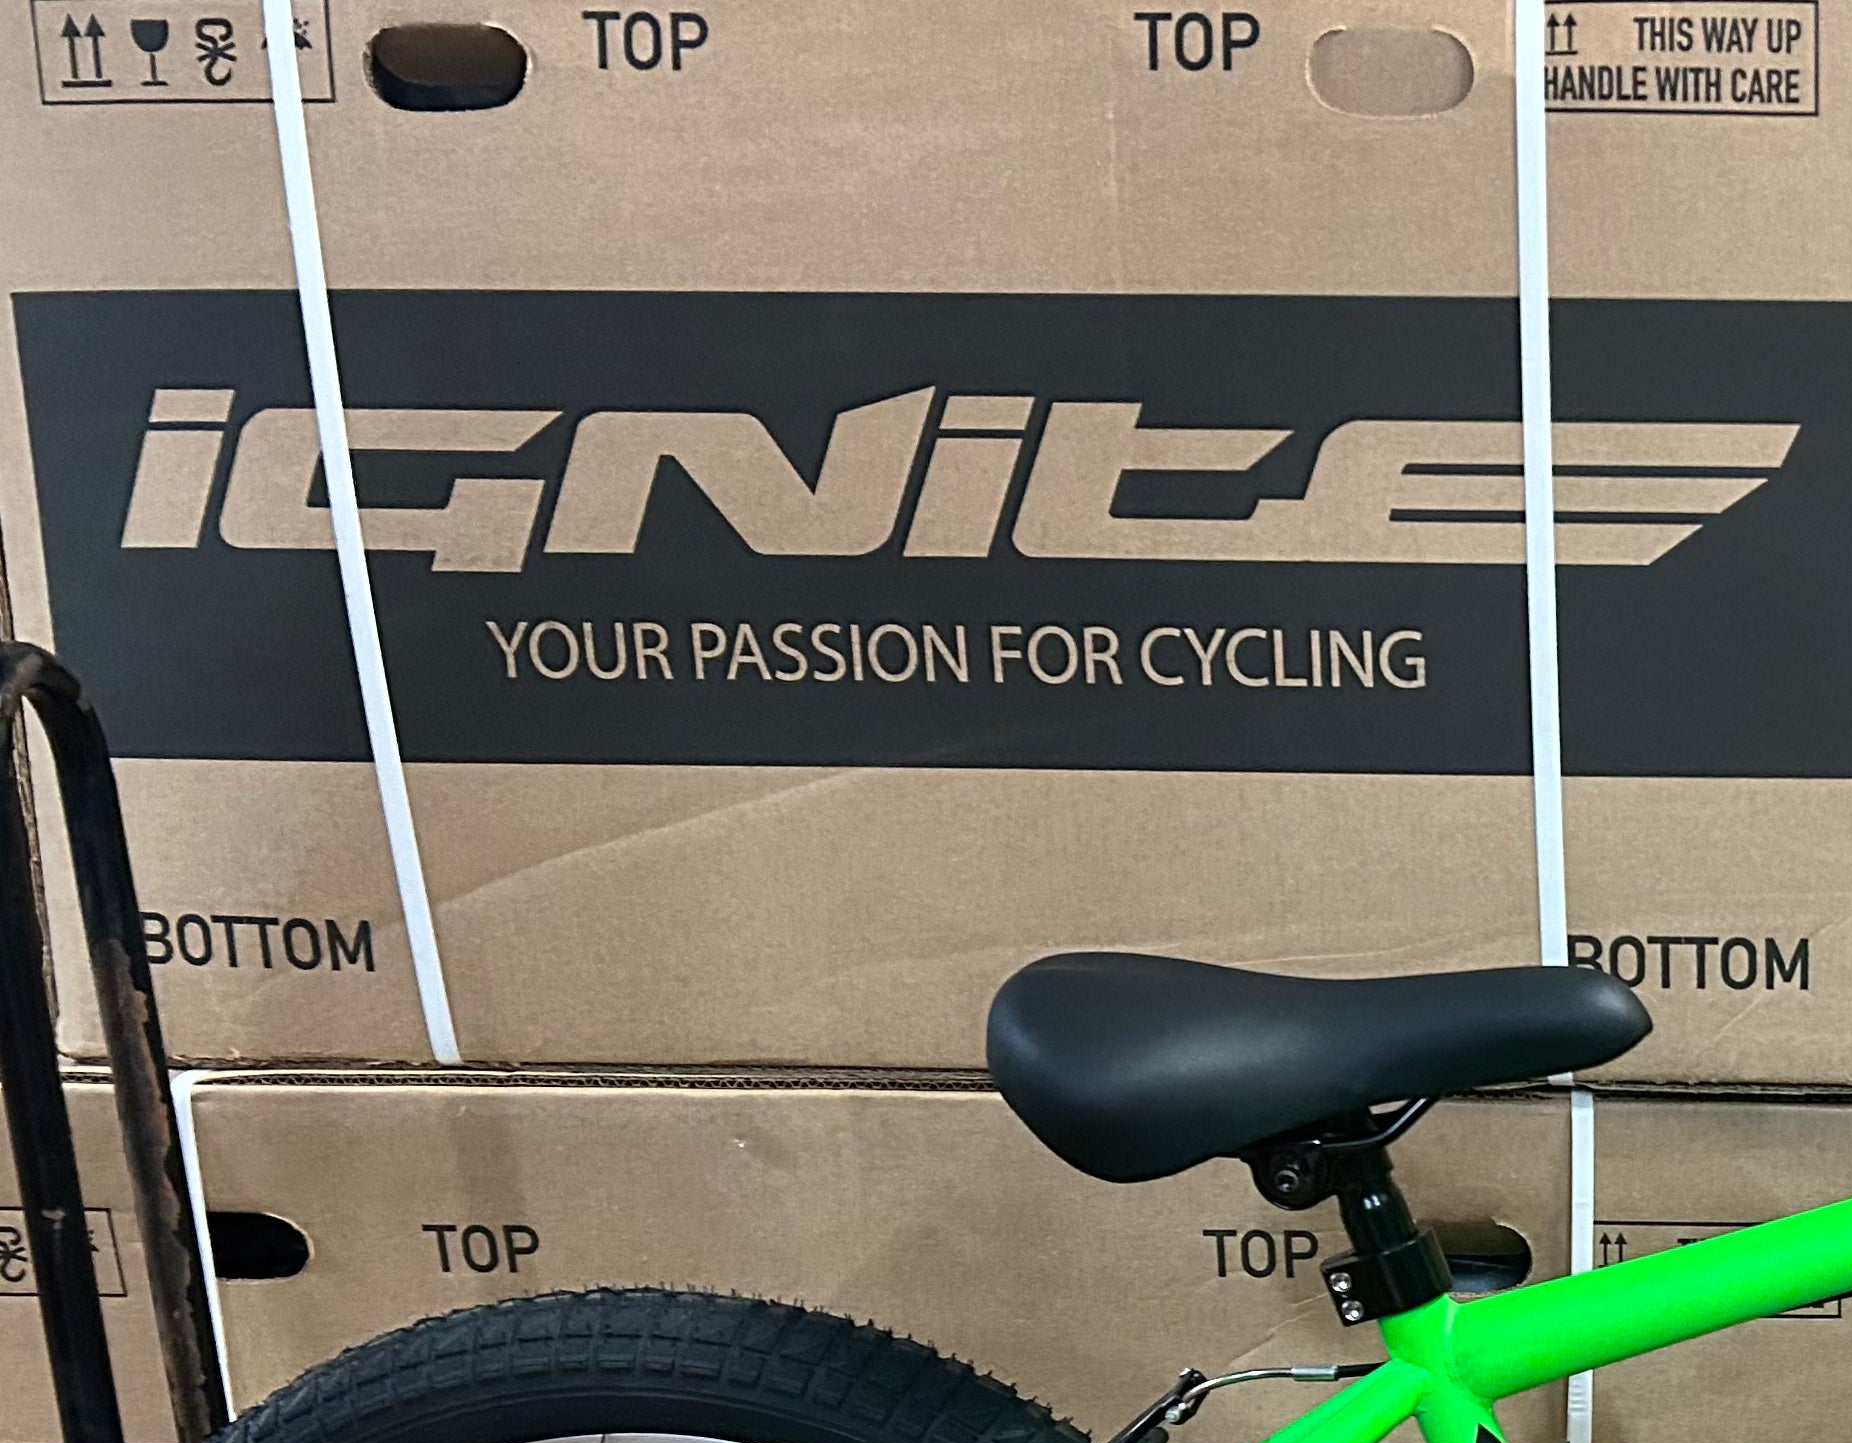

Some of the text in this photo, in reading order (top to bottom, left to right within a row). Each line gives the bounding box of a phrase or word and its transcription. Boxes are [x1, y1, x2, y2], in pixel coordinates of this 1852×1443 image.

[582, 10, 710, 72] TOP
[1134, 11, 1261, 72] TOP
[1633, 16, 1803, 55] THIS WAY UP
[1544, 65, 1802, 105] HANDLE WITH CARE
[486, 620, 1427, 690] YOUR PASSION FOR CYCLING
[139, 911, 377, 974] BOTTOM
[422, 1224, 541, 1275] TOP
[1203, 1228, 1320, 1280] TOP
